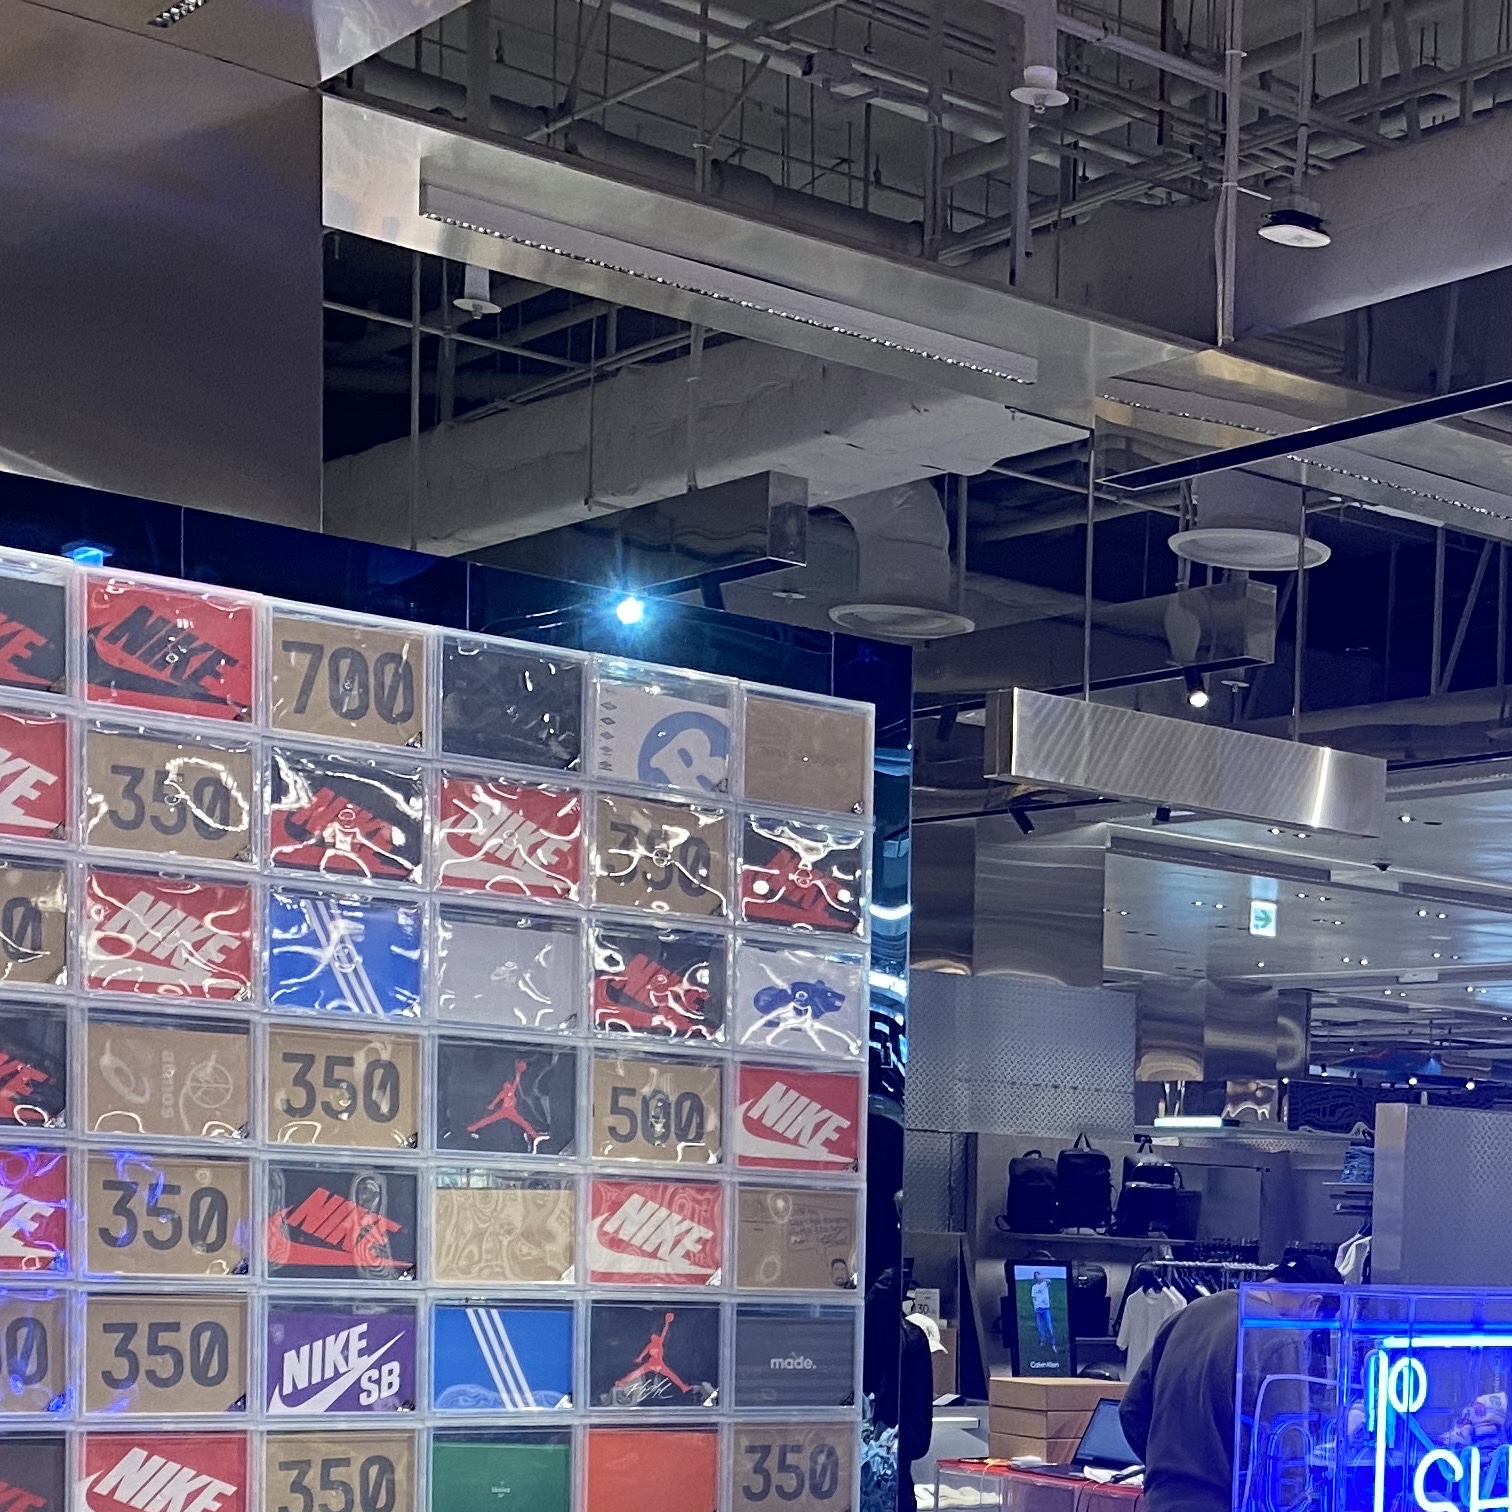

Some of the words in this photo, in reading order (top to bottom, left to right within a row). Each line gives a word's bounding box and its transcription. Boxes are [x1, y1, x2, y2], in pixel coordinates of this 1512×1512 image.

[105, 606, 238, 690] NIKE
[281, 640, 415, 725] 700
[109, 764, 235, 841] 350
[474, 801, 572, 873] NIKE
[608, 820, 712, 896] 350
[105, 890, 240, 968] NIKE
[279, 1052, 401, 1123] 350
[607, 1086, 705, 1146] 500
[748, 1081, 851, 1156] NIKE
[99, 1180, 229, 1253] 350
[287, 1187, 402, 1254] NIKE
[603, 1193, 715, 1266] NIKE
[101, 1321, 229, 1390] 350
[282, 1322, 369, 1395] NIKE
[358, 1361, 401, 1407] SB
[741, 1443, 839, 1503] 350
